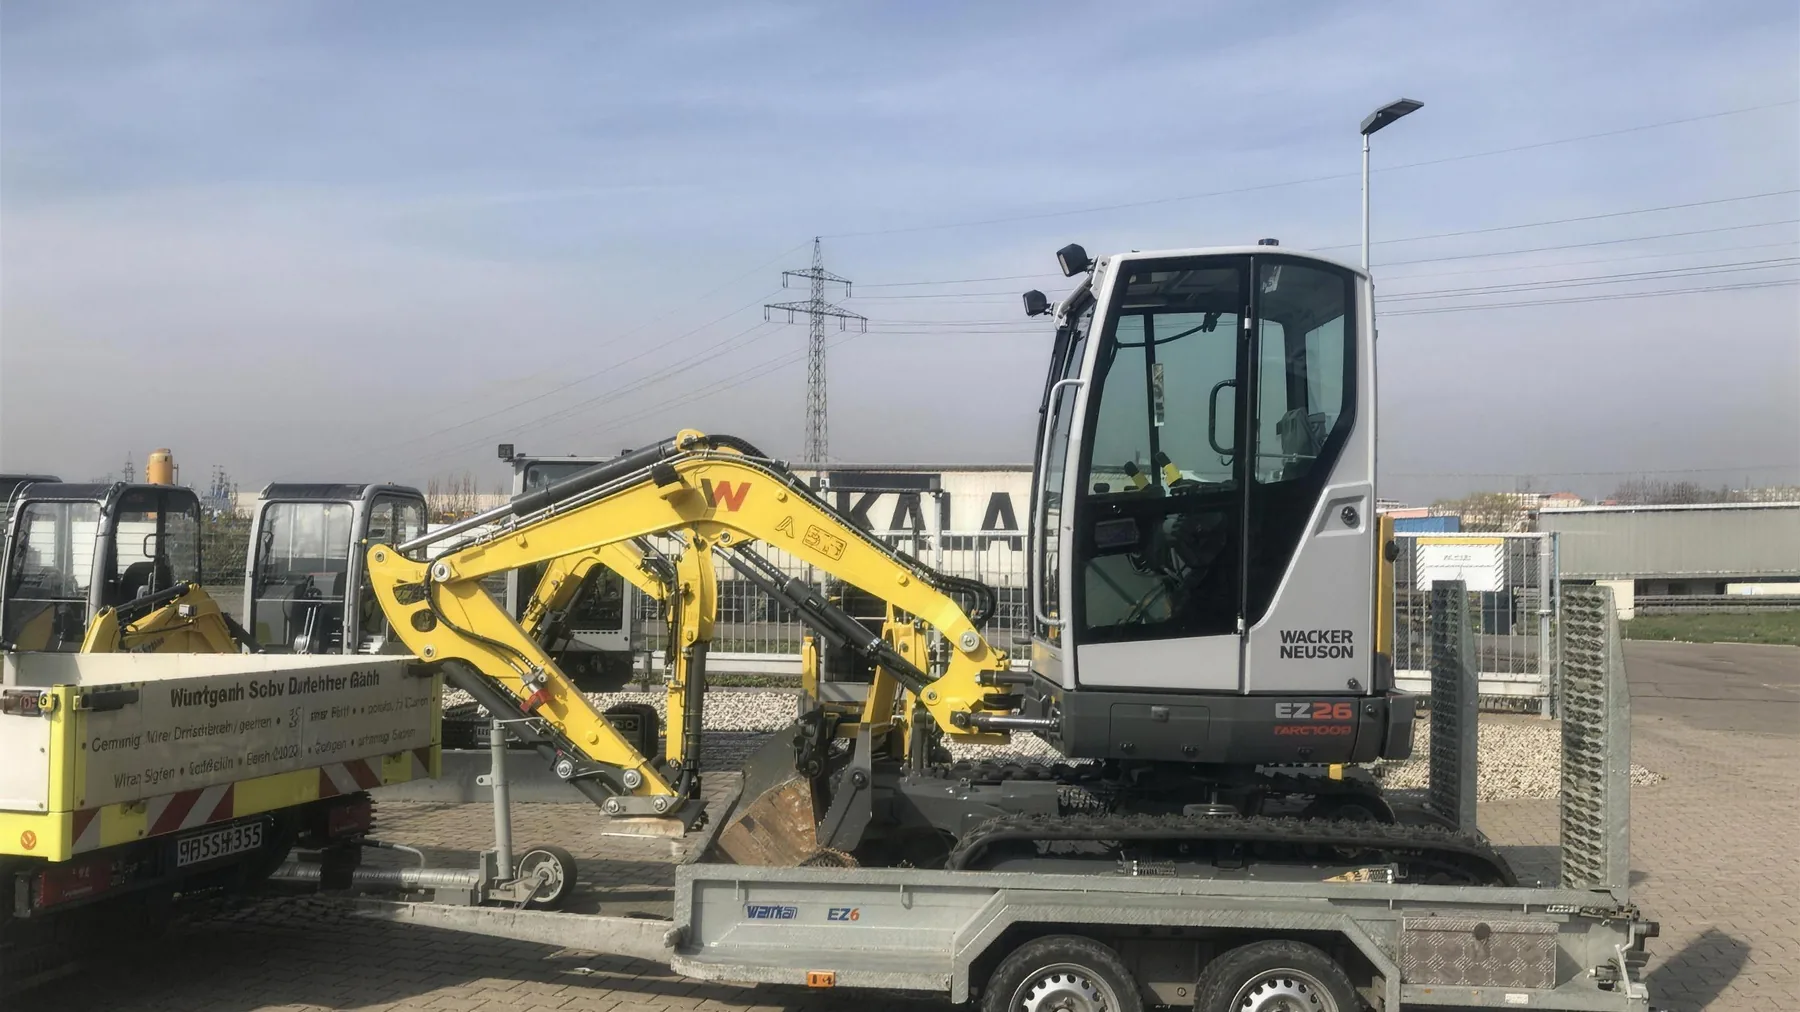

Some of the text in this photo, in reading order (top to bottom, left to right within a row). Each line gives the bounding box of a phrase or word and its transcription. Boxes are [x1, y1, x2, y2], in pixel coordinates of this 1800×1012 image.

[1280, 630, 1353, 644] WACKER
[1280, 645, 1354, 659] NEUSON
[1275, 703, 1353, 720] EZ26
[827, 907, 860, 922] EZ6
